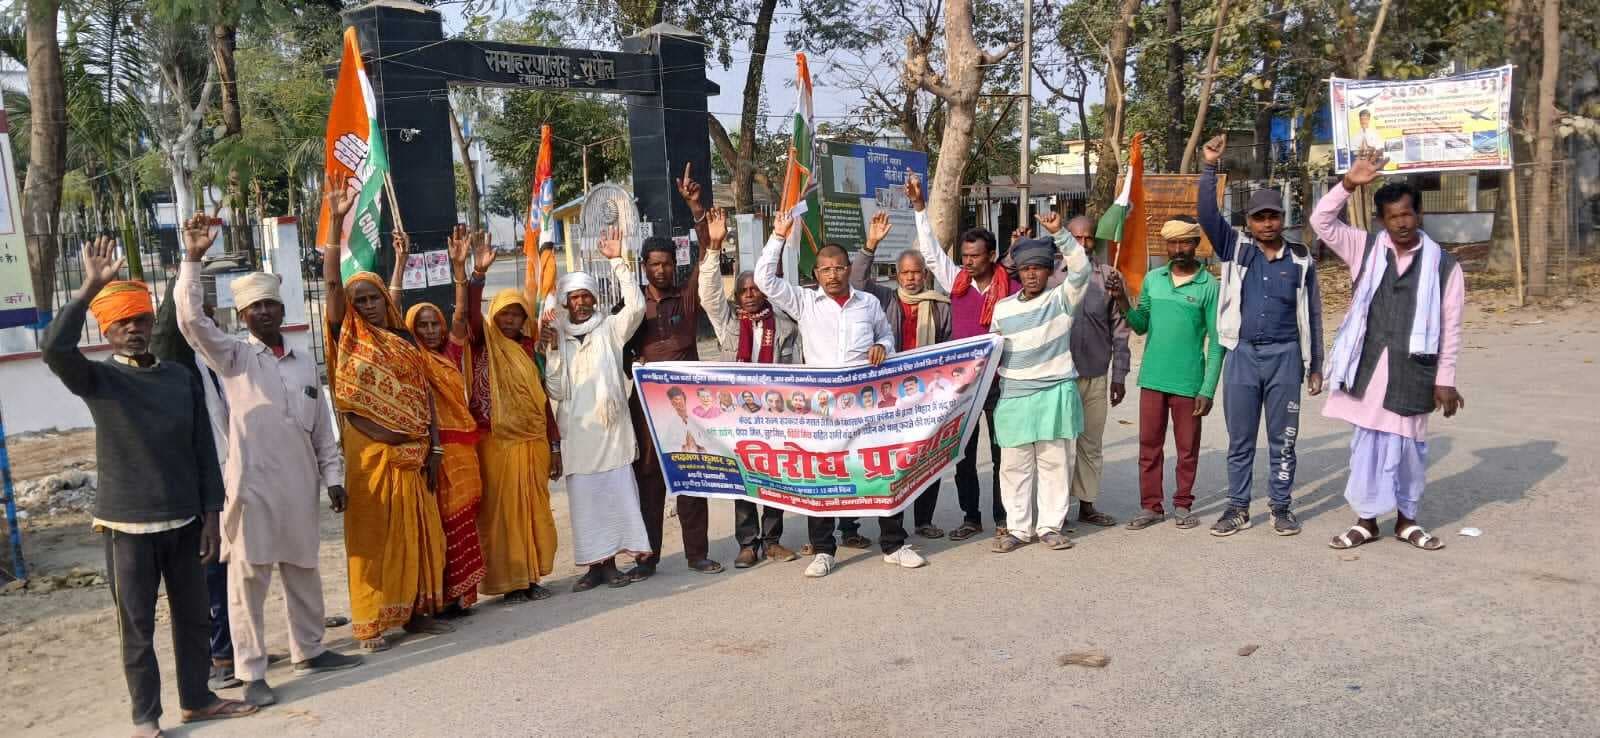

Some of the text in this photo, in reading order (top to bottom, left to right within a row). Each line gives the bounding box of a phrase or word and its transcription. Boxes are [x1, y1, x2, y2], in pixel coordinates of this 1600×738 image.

[754, 416, 765, 425] और
[914, 404, 931, 414] बिहार
[734, 440, 852, 481] विरोध
